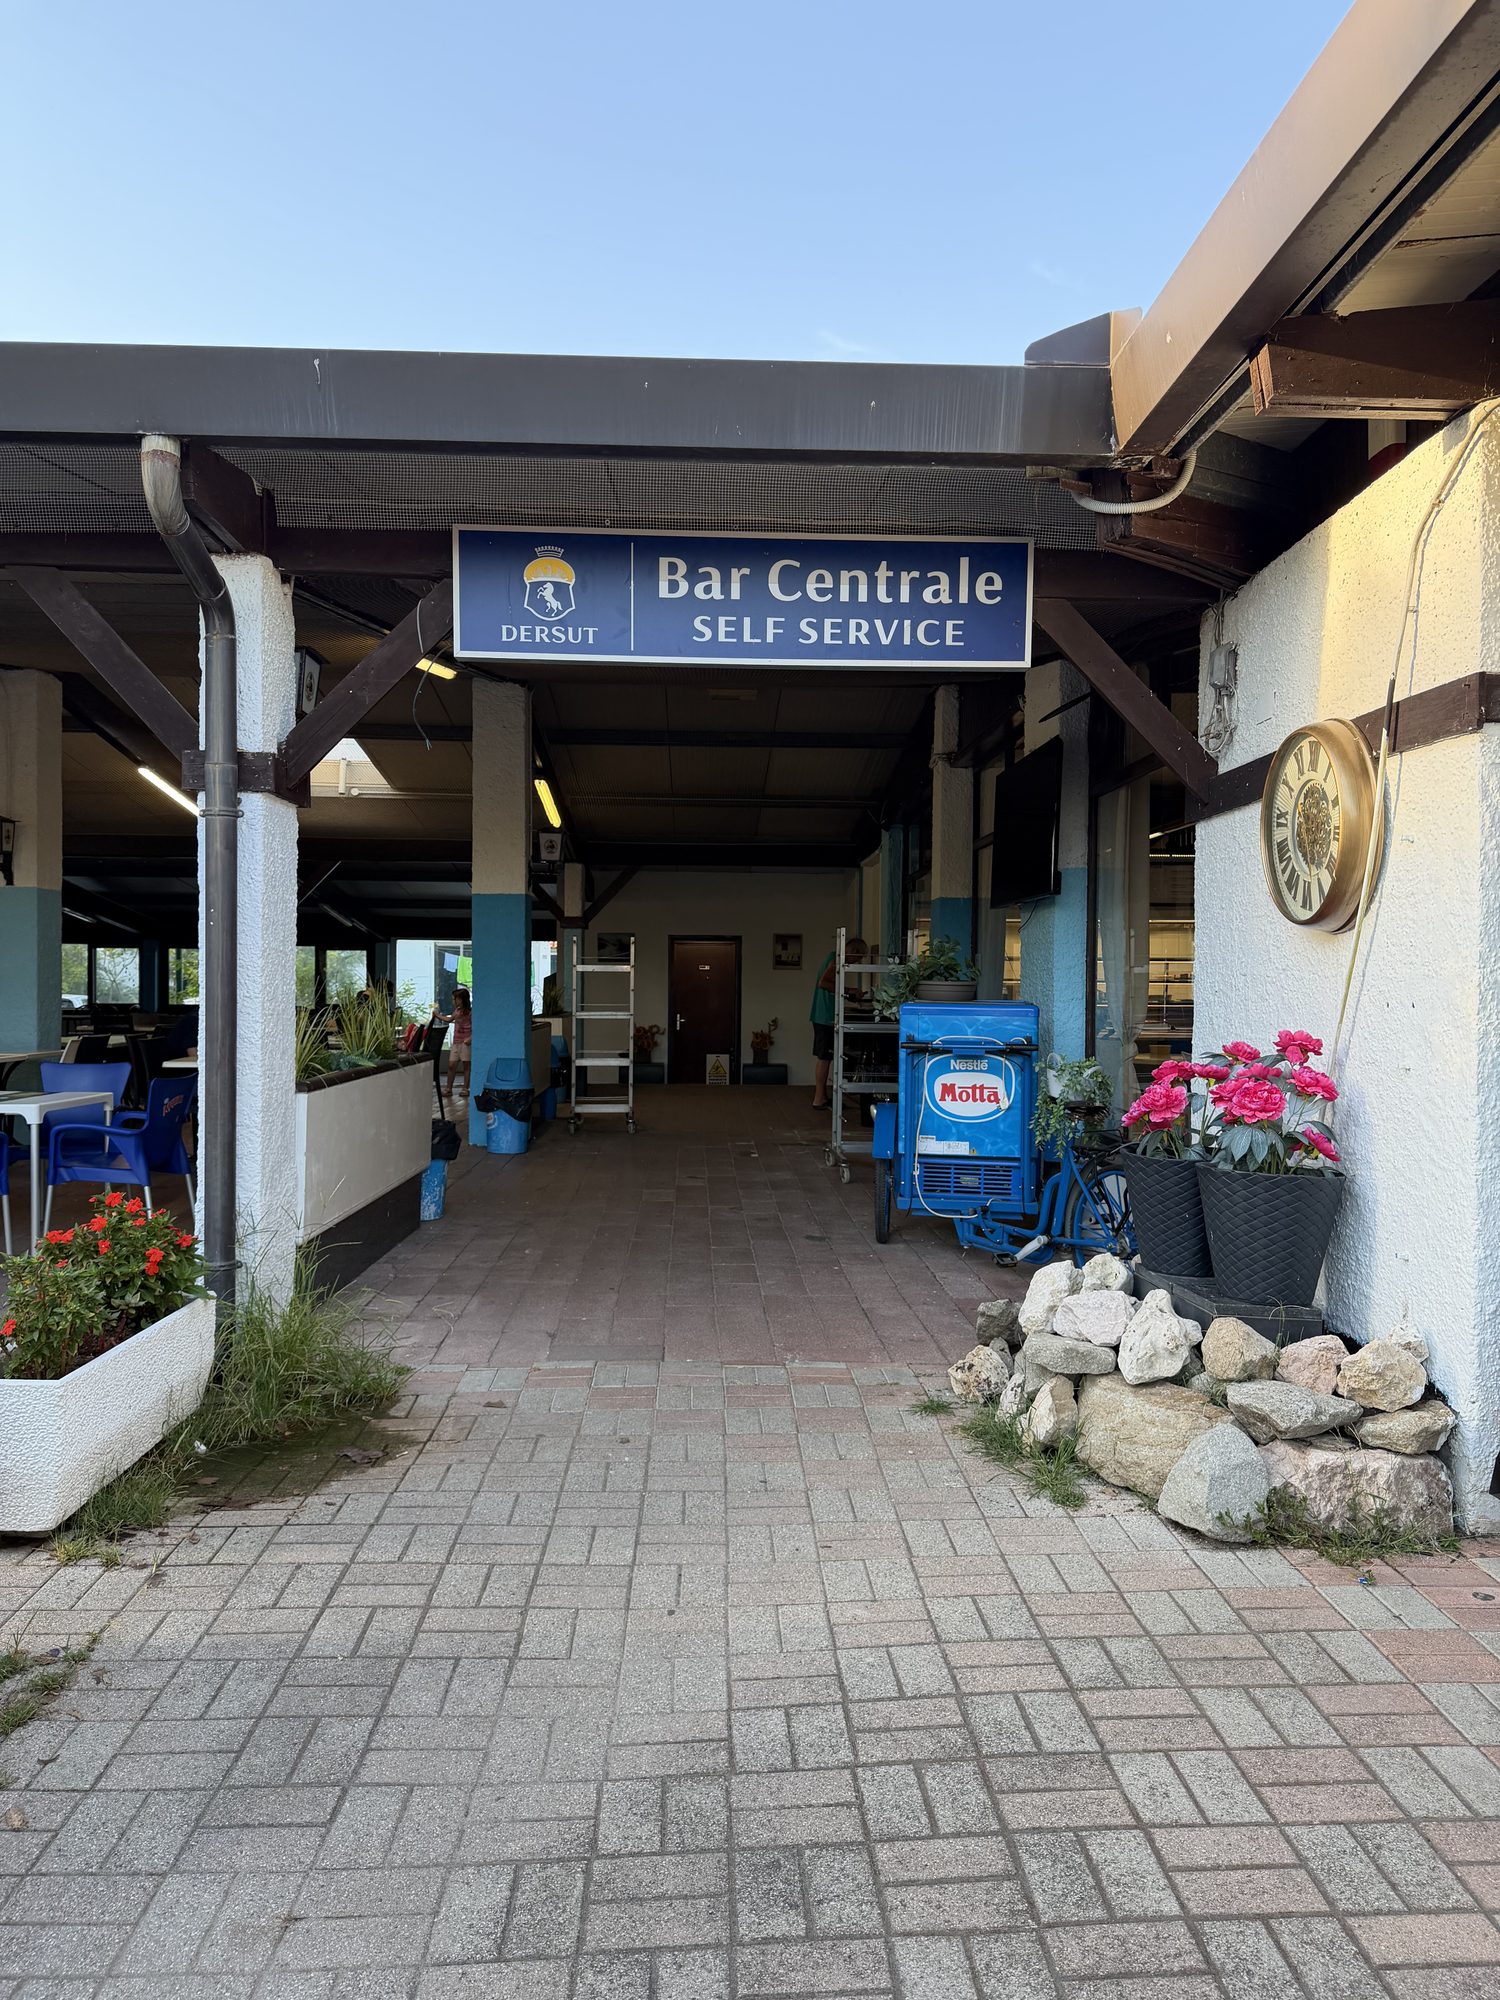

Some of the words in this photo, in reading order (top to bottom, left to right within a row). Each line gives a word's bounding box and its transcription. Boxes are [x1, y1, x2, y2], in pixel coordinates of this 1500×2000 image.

[658, 556, 750, 600] Bar
[767, 556, 1003, 605] Centrale
[501, 624, 599, 644] DERSUT
[692, 615, 785, 643] SELF
[798, 617, 965, 646] SERVICE
[950, 1059, 988, 1070] Nestlé
[939, 1083, 1000, 1104] Motta
